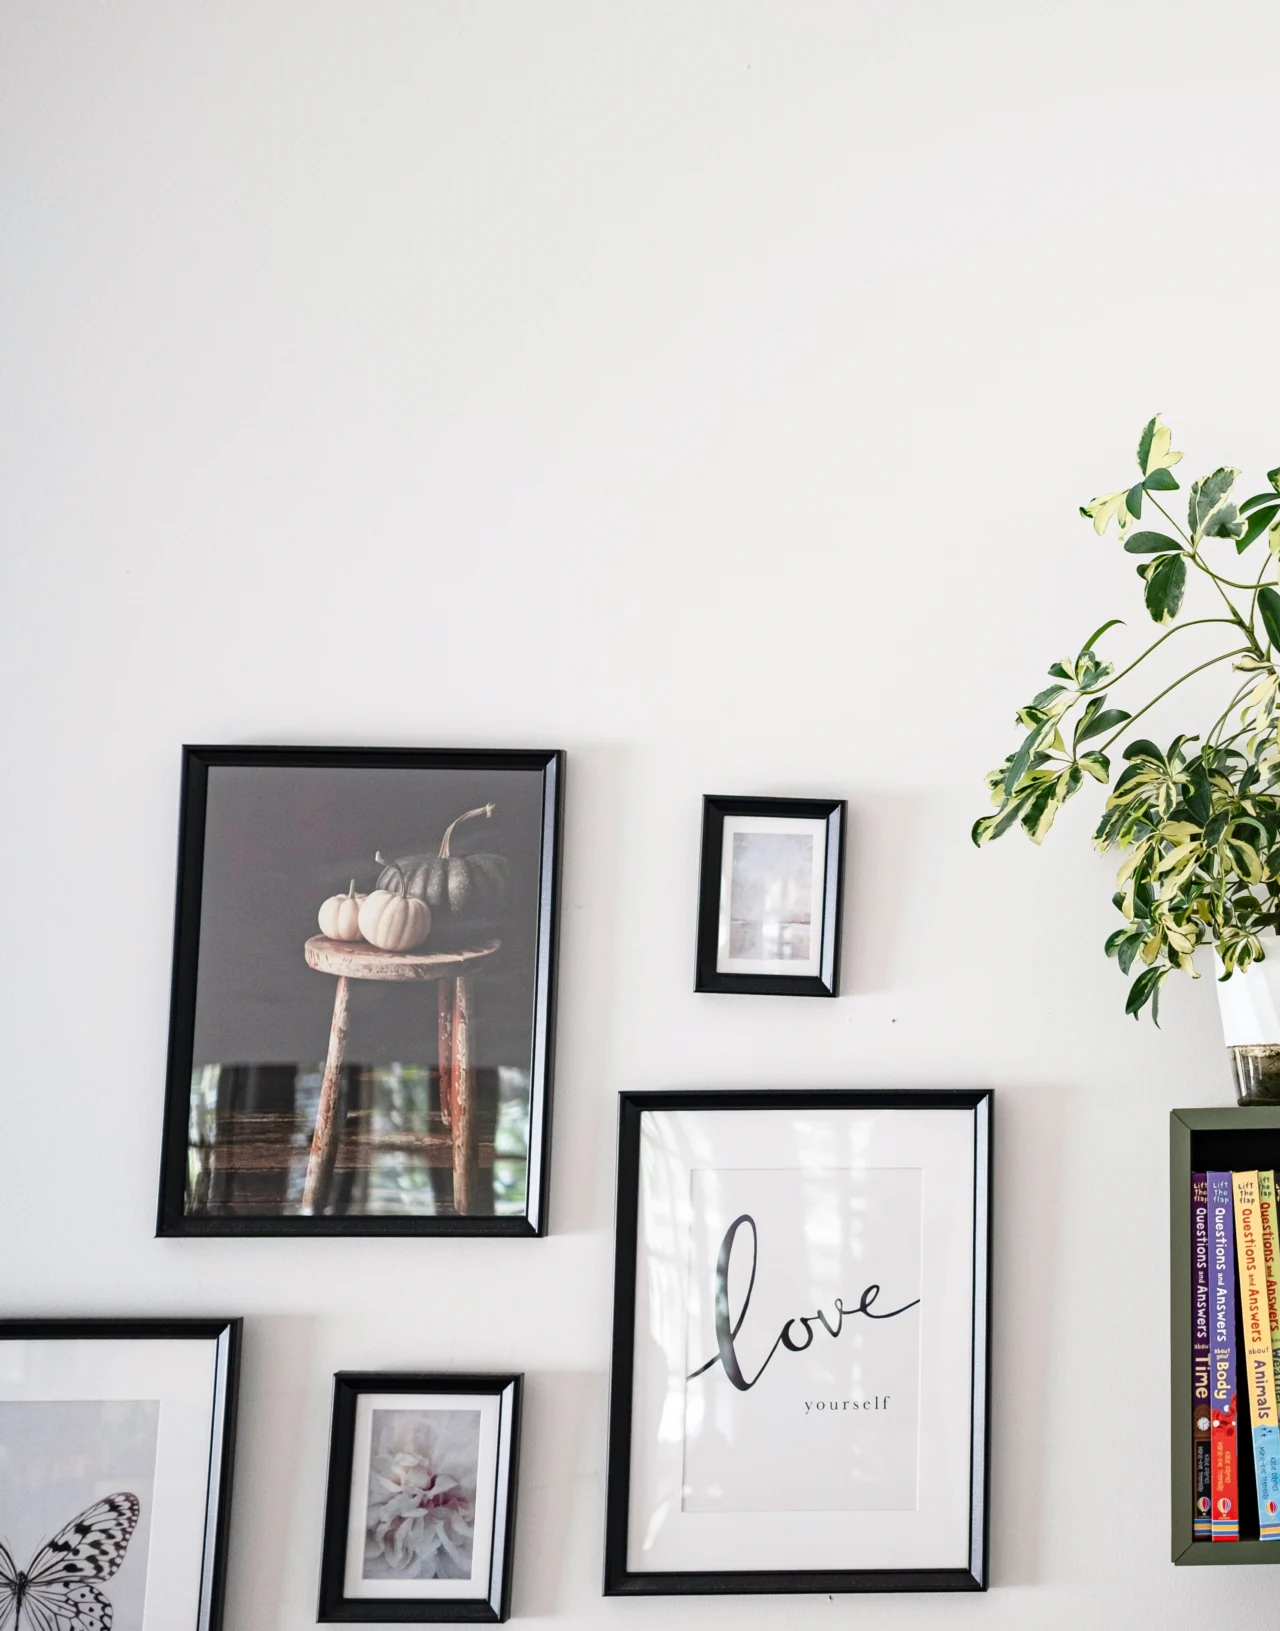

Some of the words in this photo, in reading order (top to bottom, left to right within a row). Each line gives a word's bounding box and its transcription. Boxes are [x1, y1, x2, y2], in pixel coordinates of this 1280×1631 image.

[1212, 1181, 1228, 1189] Lift
[1213, 1196, 1229, 1205] flap
[1238, 1181, 1253, 1189] Lift
[1240, 1197, 1255, 1205] flap
[1260, 1190, 1271, 1198] lap
[1196, 1207, 1208, 1269] Questions
[1215, 1207, 1227, 1270] Questions
[1242, 1208, 1257, 1271] Questions
[1260, 1202, 1274, 1263] Questions
[1248, 1274, 1257, 1286] and
[1266, 1265, 1274, 1278] and
[686, 1214, 920, 1391] love
[1197, 1285, 1208, 1338] Answers
[1216, 1287, 1227, 1342] Answers
[1248, 1288, 1262, 1343] Answers
[1266, 1280, 1279, 1332] Answers
[1248, 1347, 1269, 1355] about
[1195, 1353, 1211, 1399] Time
[1213, 1361, 1231, 1399] Body
[1254, 1359, 1271, 1419] Animals
[804, 1395, 891, 1415] yourself
